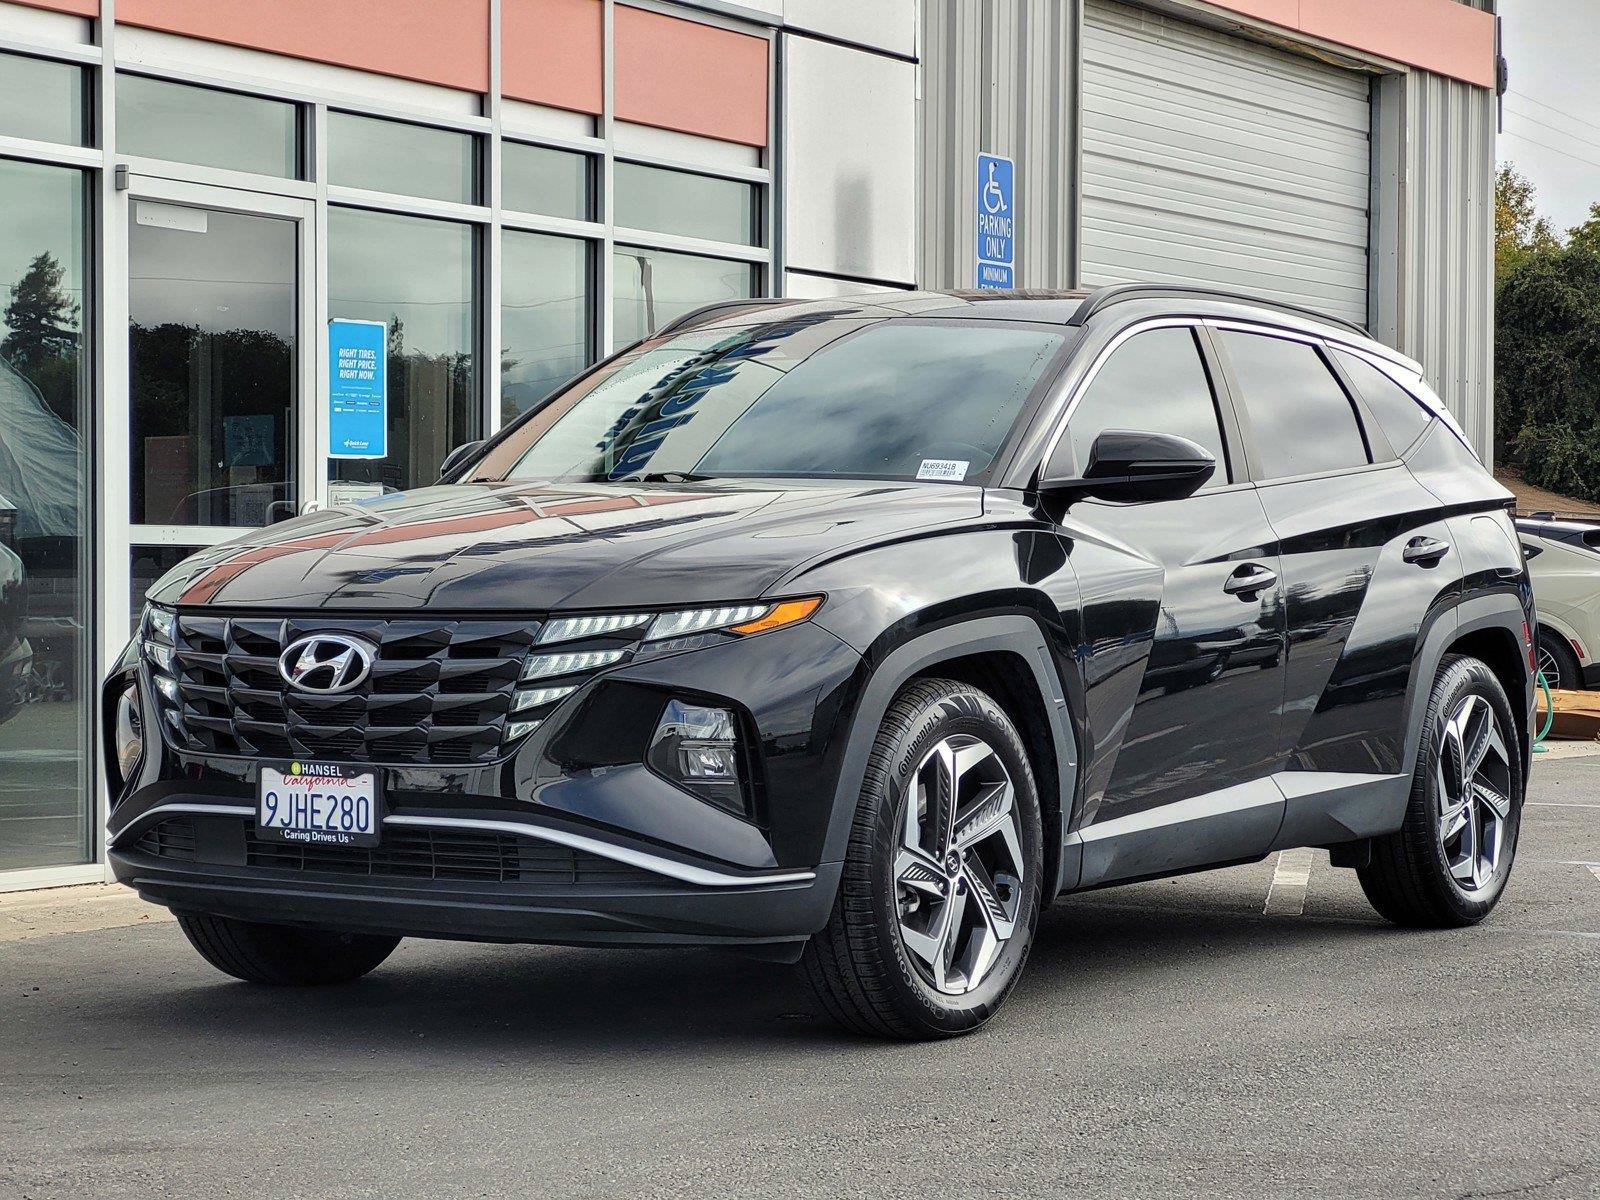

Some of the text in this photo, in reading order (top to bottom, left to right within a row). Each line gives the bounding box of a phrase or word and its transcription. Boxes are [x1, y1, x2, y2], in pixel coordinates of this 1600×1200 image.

[979, 213, 1012, 238] PARKING
[985, 237, 1006, 259] ONLY
[982, 266, 1008, 283] MINIMUM
[338, 348, 376, 360] RIGHT TIRES.
[338, 359, 377, 370] RIGHT PRICE.
[339, 370, 374, 380] RIGHT NOW.
[898, 716, 935, 778] Continental
[302, 764, 343, 777] HANSEL
[282, 774, 356, 792] California
[265, 791, 369, 832] 9JHE280
[284, 830, 349, 844] Caring Drives Us
